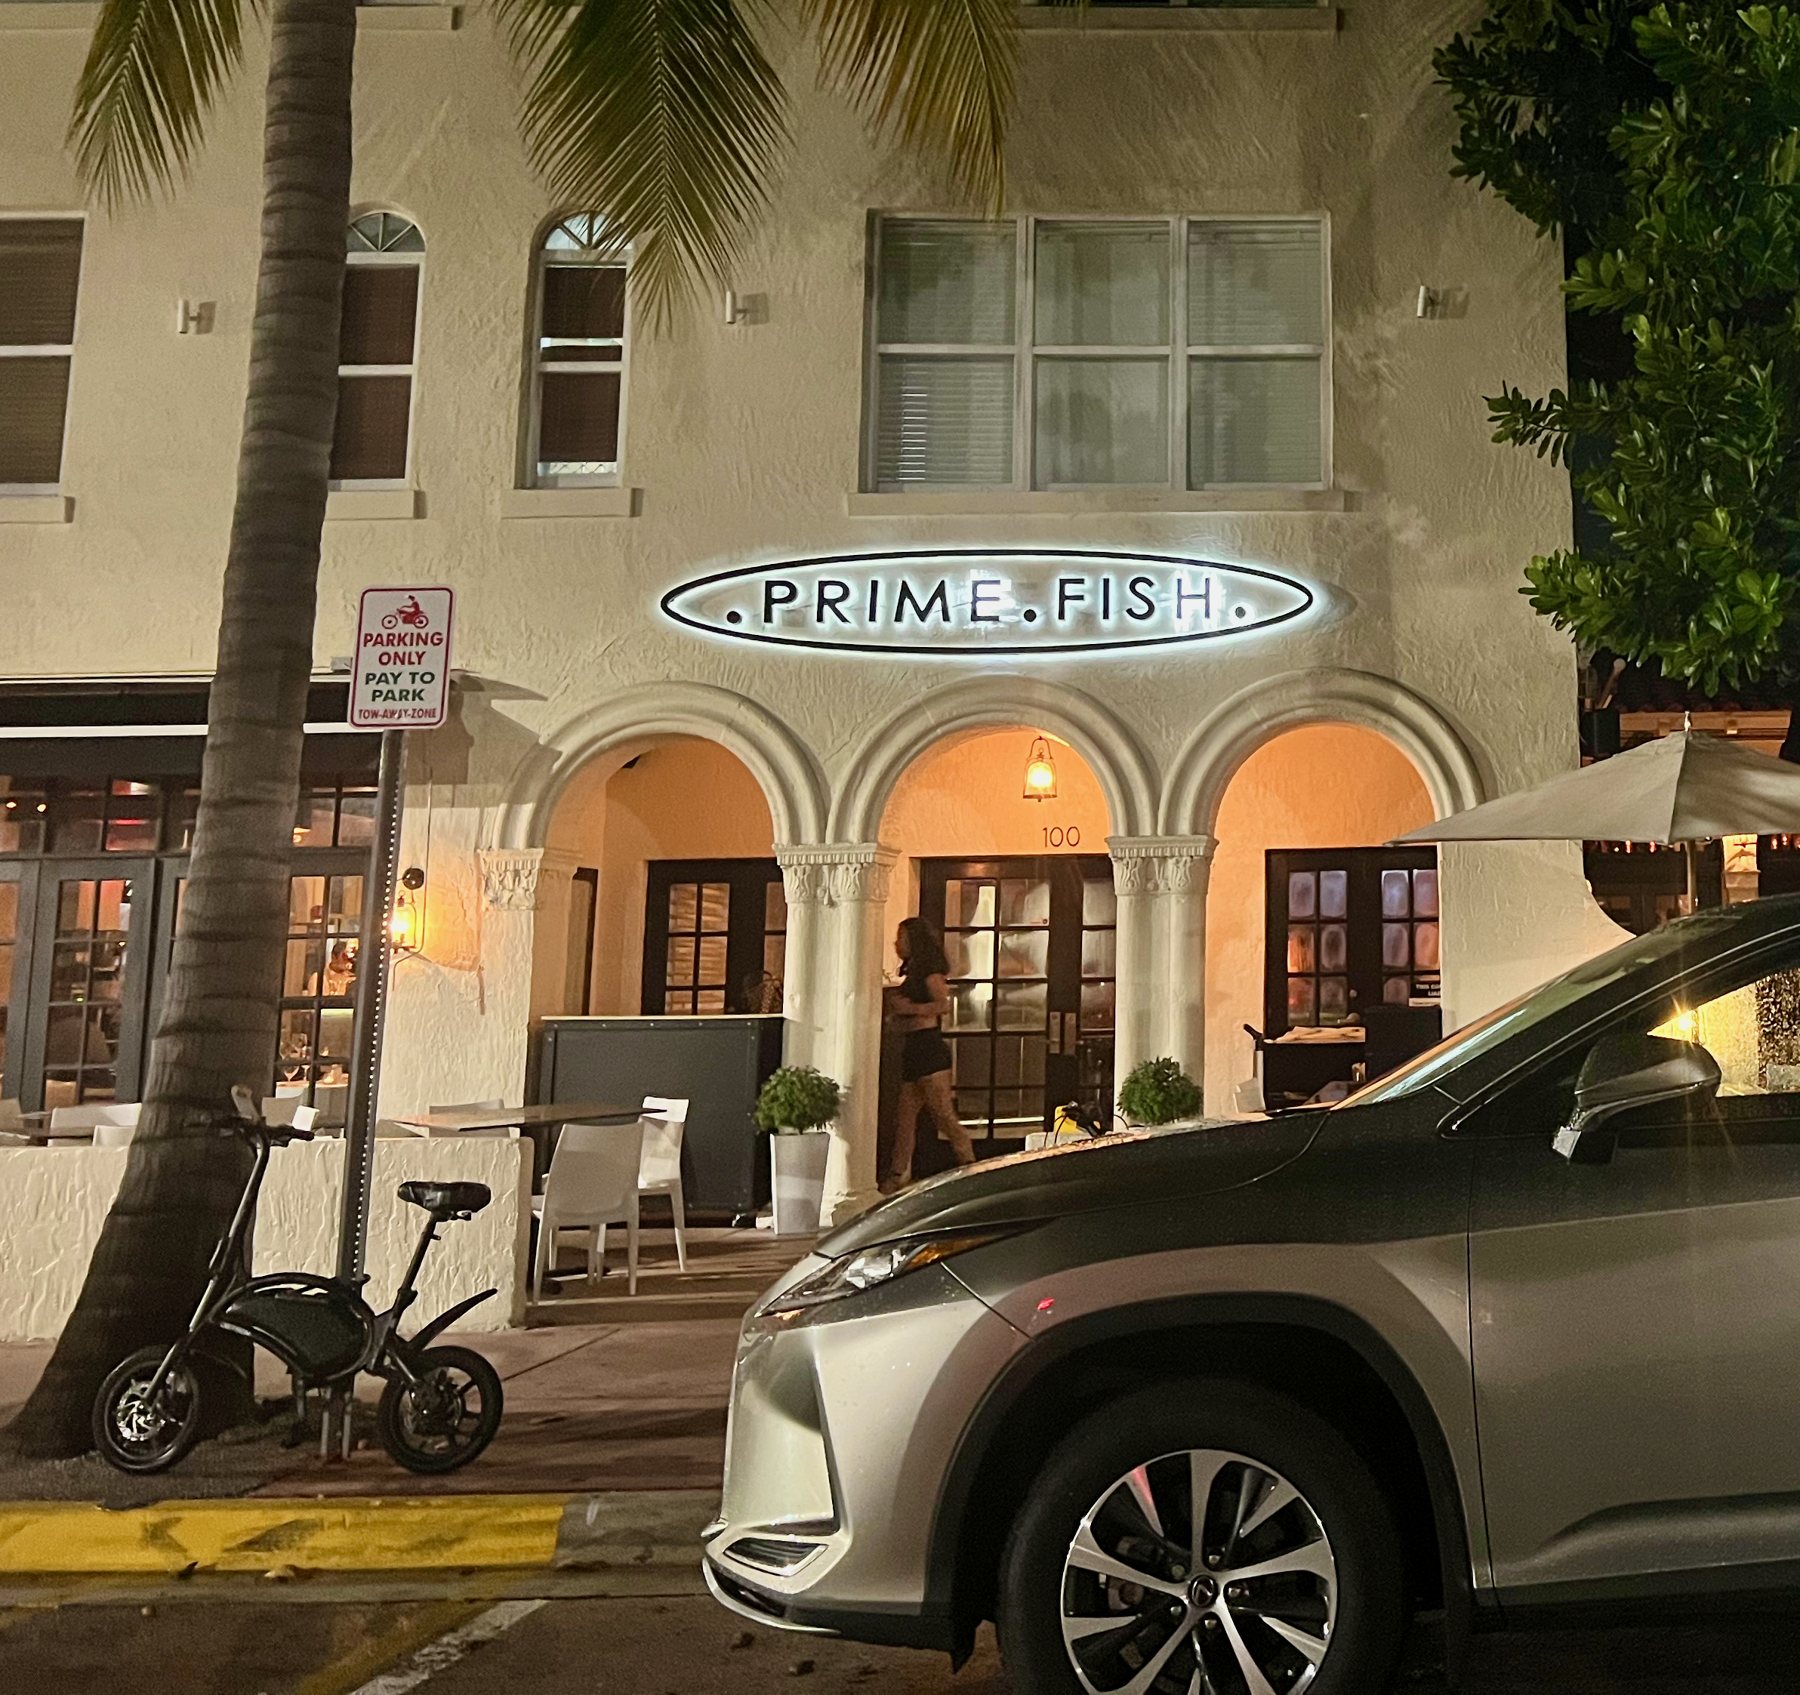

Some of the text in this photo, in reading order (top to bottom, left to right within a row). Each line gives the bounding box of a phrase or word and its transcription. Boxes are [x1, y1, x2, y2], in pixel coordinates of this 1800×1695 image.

[363, 632, 443, 647] PARKING
[378, 652, 425, 665] ONLY
[365, 672, 435, 685] PAY TO
[372, 689, 424, 702] PARK
[1042, 826, 1081, 849] 100
